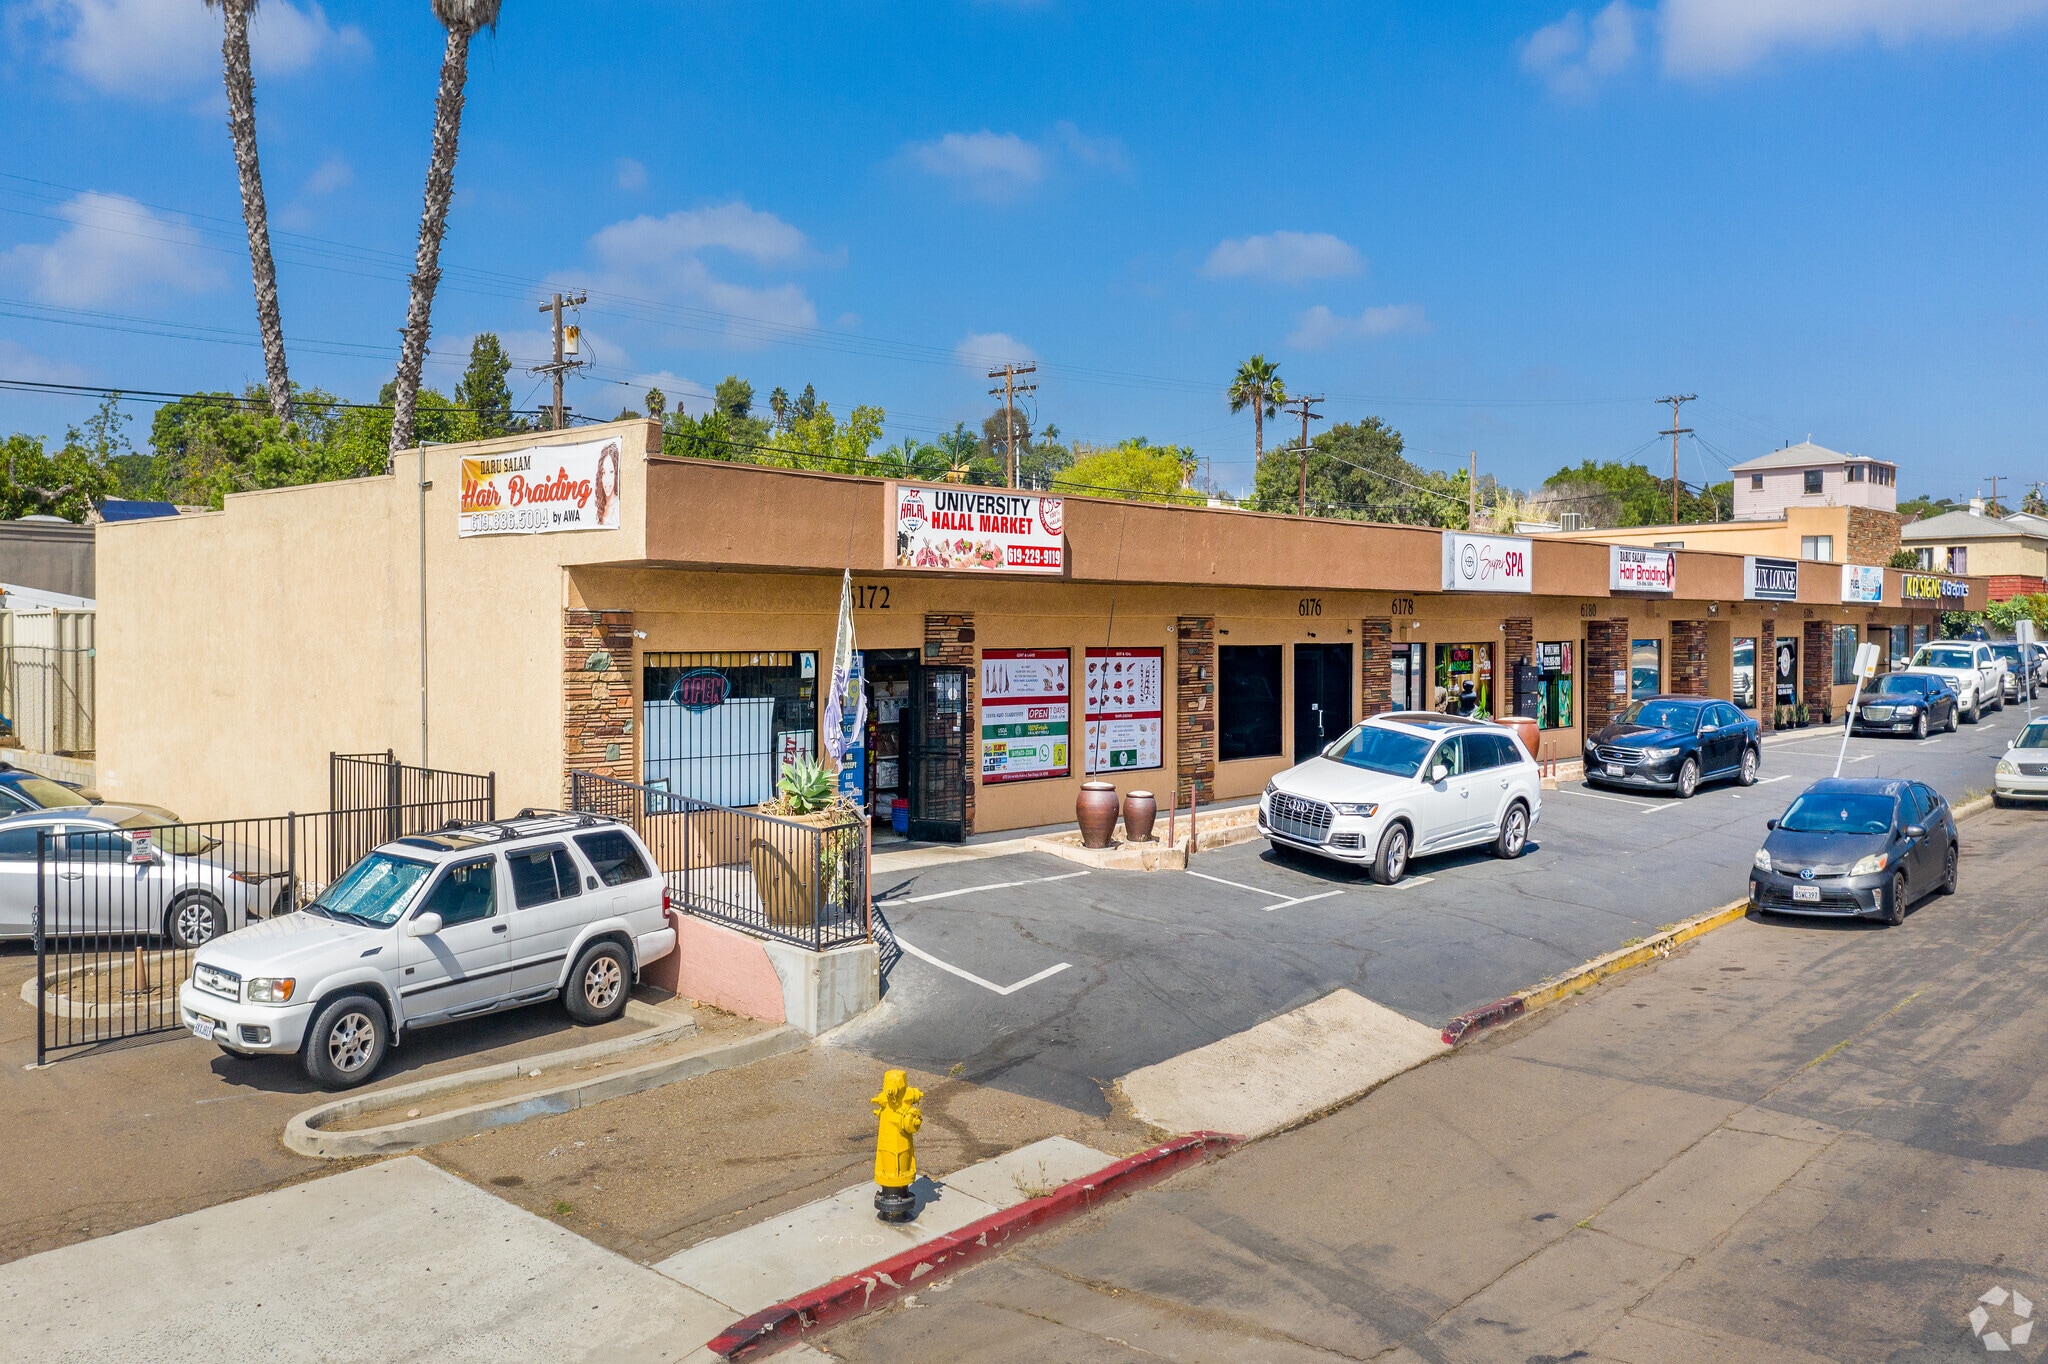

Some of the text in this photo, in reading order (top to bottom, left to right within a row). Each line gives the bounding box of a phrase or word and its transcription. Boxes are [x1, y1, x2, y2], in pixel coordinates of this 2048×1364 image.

[480, 455, 531, 475] DARU SALAM
[462, 466, 592, 510] Hair Braiding
[900, 502, 928, 522] HALAL
[935, 491, 1031, 516] UNIVERSITY
[471, 508, 549, 532] 619.886.5004
[552, 509, 581, 525] by AWA
[931, 511, 975, 532] HALAL
[979, 514, 1033, 535] MARKET
[1008, 547, 1061, 565] 619-229-9119
[1505, 551, 1524, 577] SPA
[1620, 563, 1666, 585] Hair Braiding
[1755, 569, 1796, 590] LUX LOUNGE
[1919, 577, 1941, 598] SIGNS
[1946, 580, 1970, 598] Graphics
[1298, 598, 1322, 616] 6176
[1391, 598, 1414, 615] 6178
[1580, 603, 1597, 617] 6180
[804, 656, 812, 669] A
[681, 677, 725, 704] OPEN
[1028, 709, 1049, 719] OPEN
